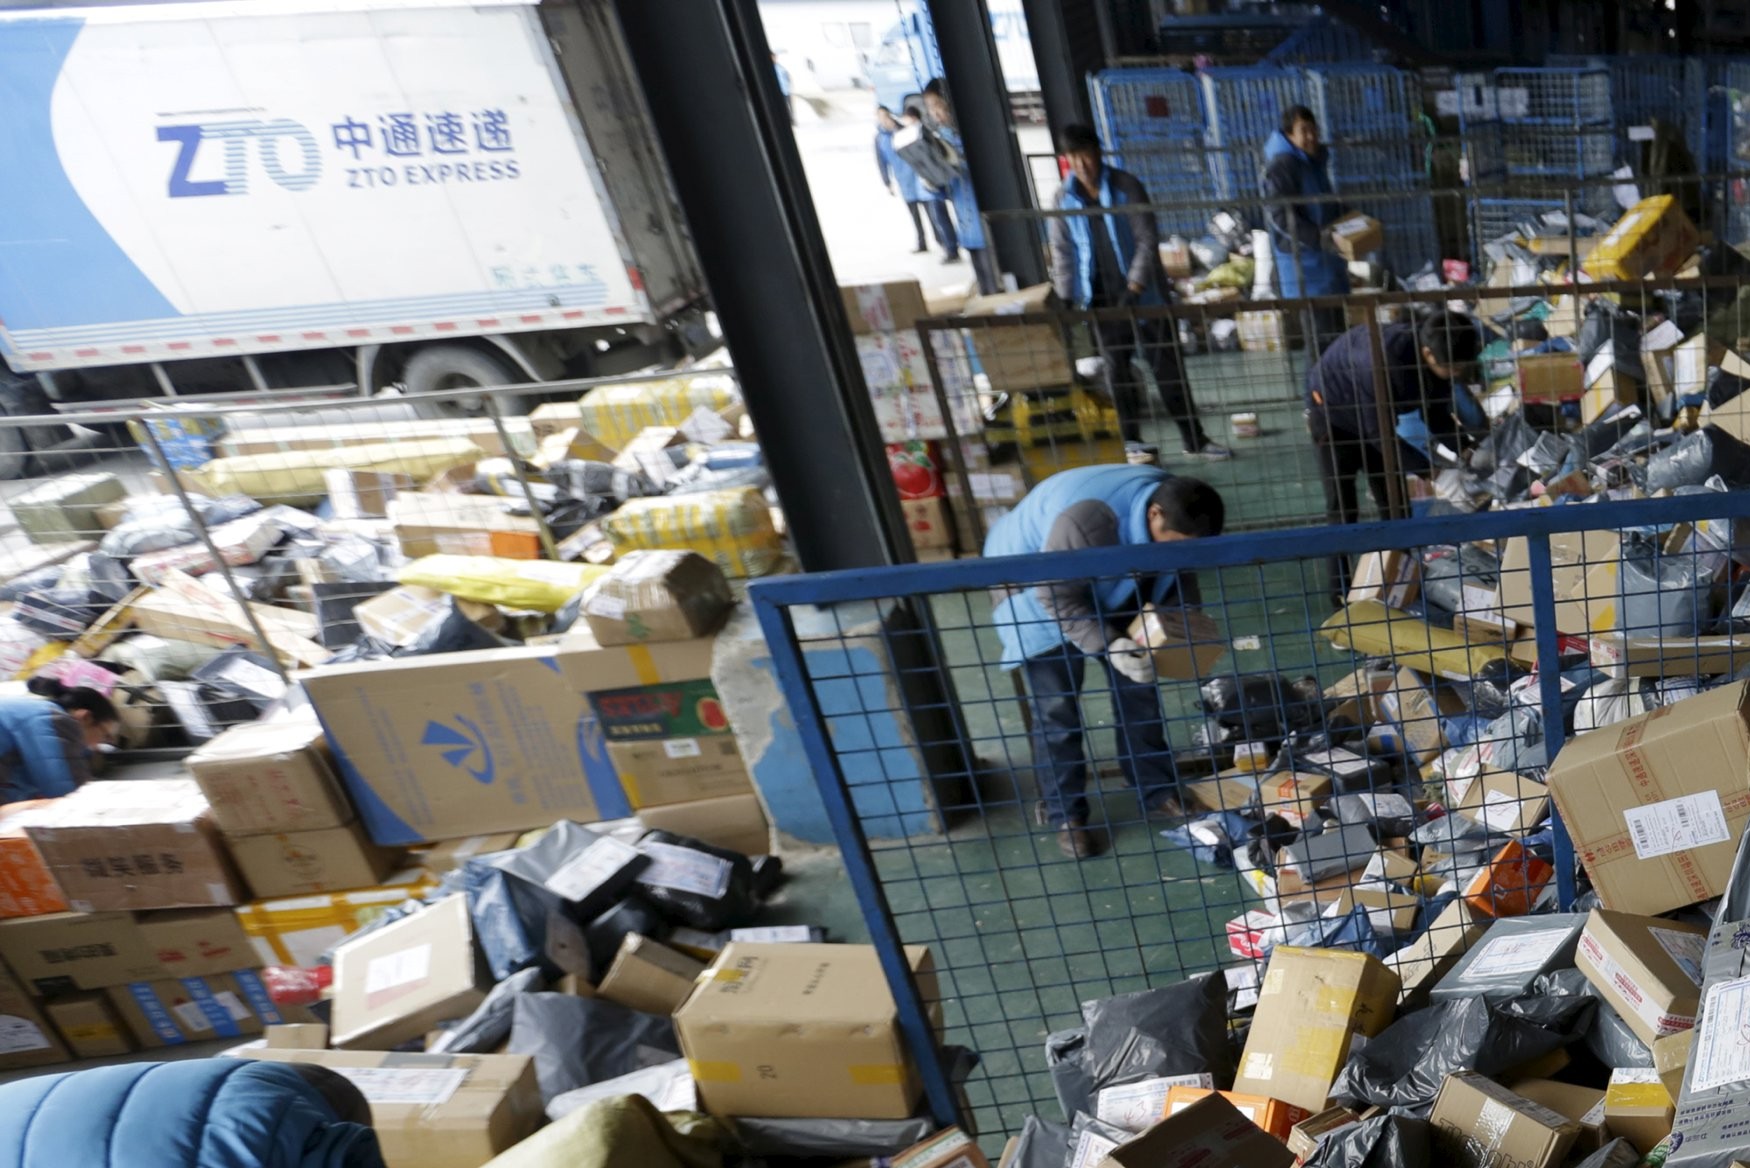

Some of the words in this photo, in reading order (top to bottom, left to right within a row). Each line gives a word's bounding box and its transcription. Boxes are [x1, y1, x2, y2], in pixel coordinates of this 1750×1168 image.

[155, 117, 323, 197] ZTO
[333, 109, 513, 160] 中通速递
[346, 167, 398, 190] ZTO
[407, 160, 521, 186] EXPRESS
